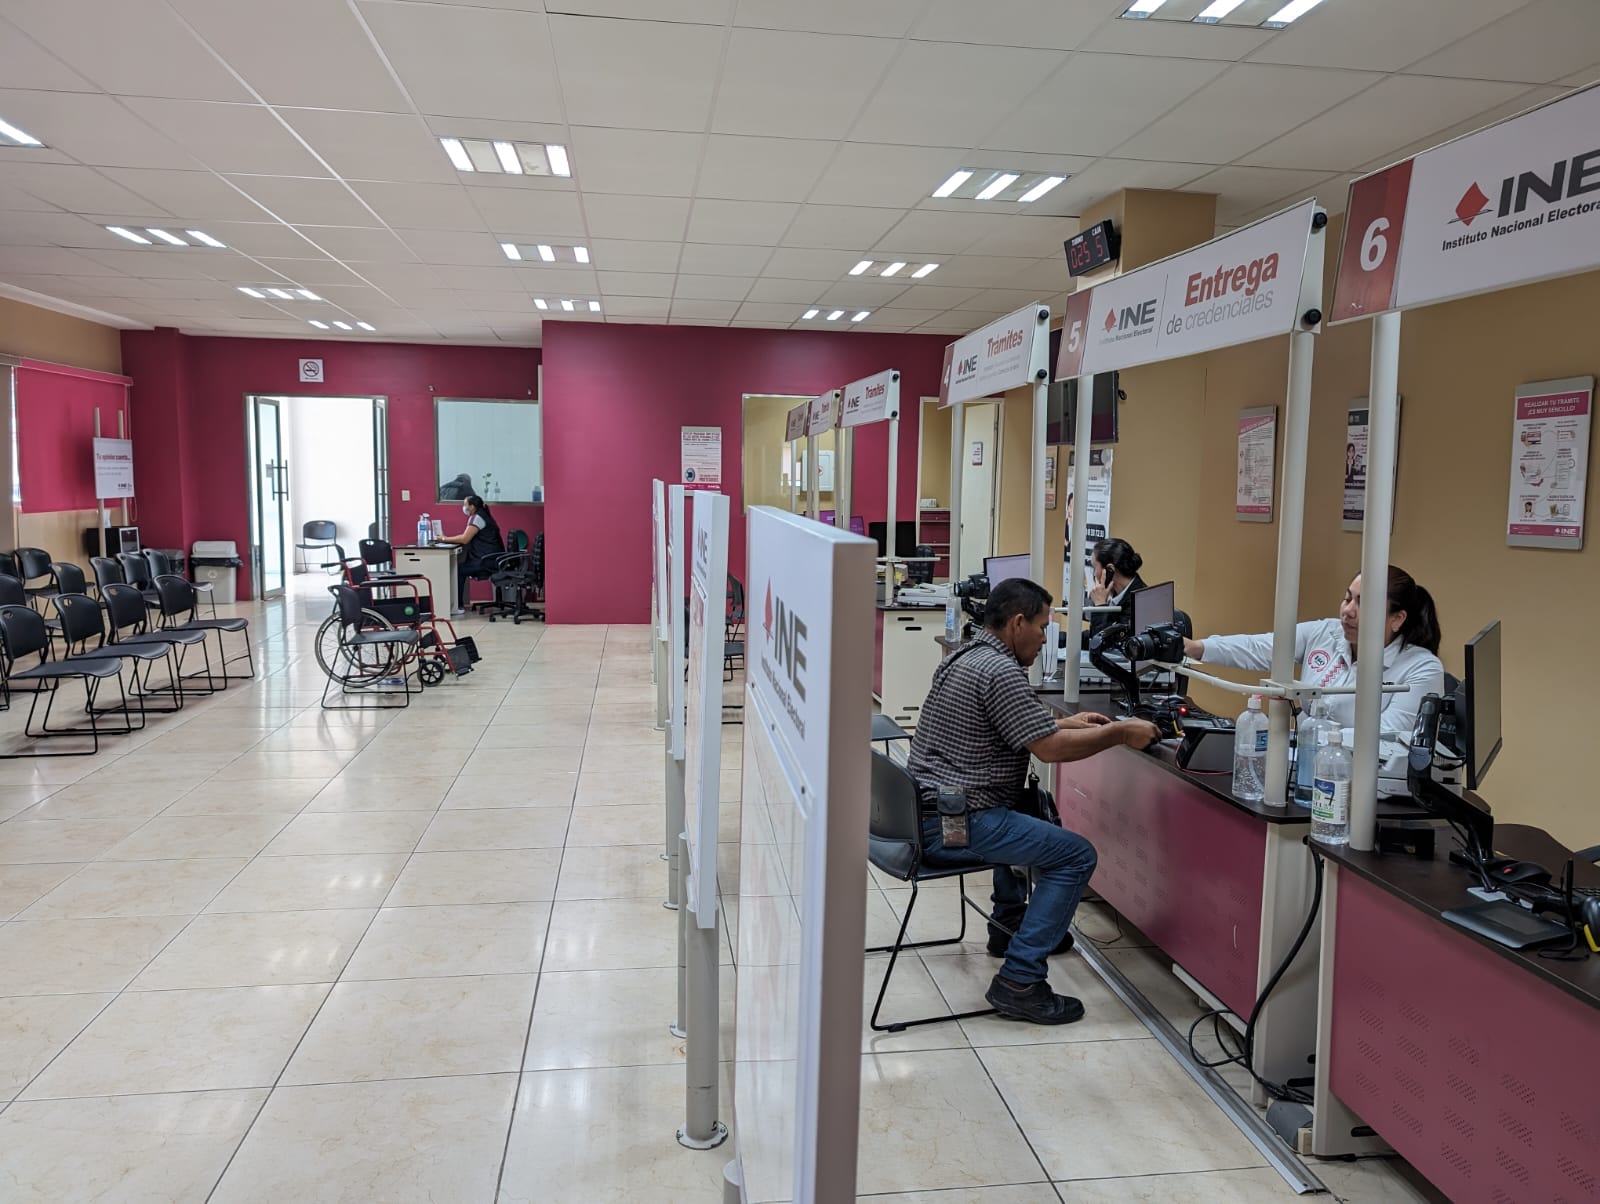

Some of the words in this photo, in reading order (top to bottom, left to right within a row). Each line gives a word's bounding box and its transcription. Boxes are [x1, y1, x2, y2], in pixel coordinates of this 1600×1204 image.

[1498, 149, 1600, 218] INE
[1360, 217, 1390, 272] 6
[1442, 231, 1487, 250] Instituto
[1491, 214, 1544, 238] Nacional
[1185, 252, 1279, 307] Entrega
[1118, 298, 1157, 331] INE
[1166, 313, 1182, 335] de
[1185, 289, 1274, 328] credenciales
[986, 328, 1024, 359] Trámites
[1068, 320, 1082, 353] 5
[944, 364, 951, 389] 4
[963, 354, 978, 375] INE
[774, 595, 808, 704] INE
